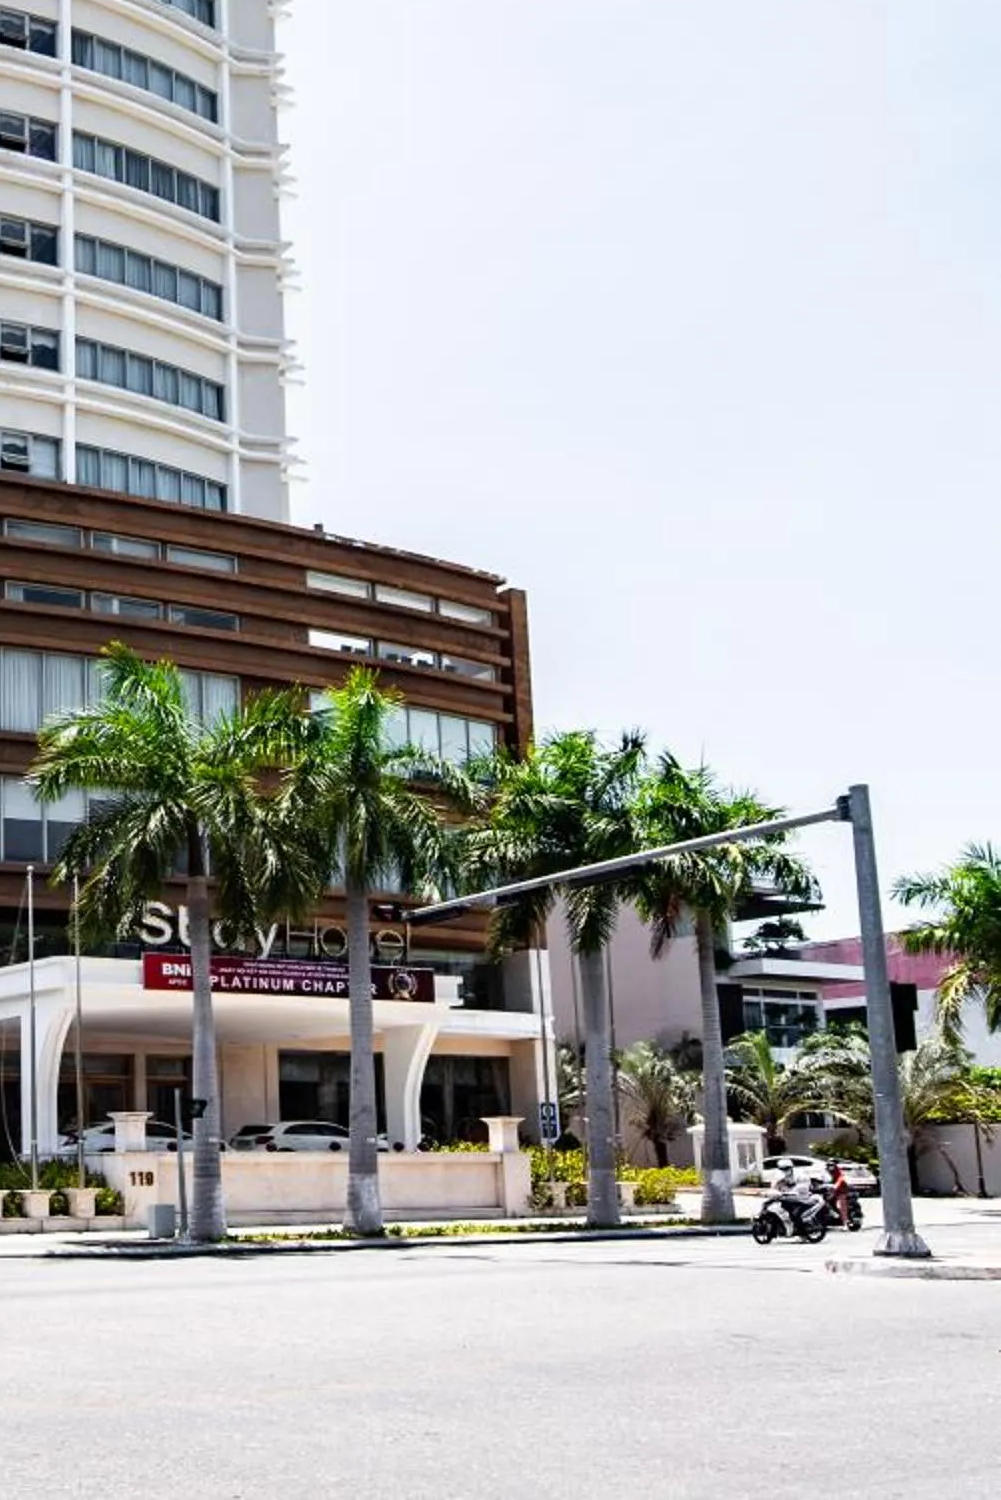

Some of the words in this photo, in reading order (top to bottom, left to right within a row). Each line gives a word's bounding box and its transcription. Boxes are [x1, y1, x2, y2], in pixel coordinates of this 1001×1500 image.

[285, 913, 411, 962] Hoel
[209, 975, 295, 991] PLATINUM
[301, 979, 378, 996] CHAPR
